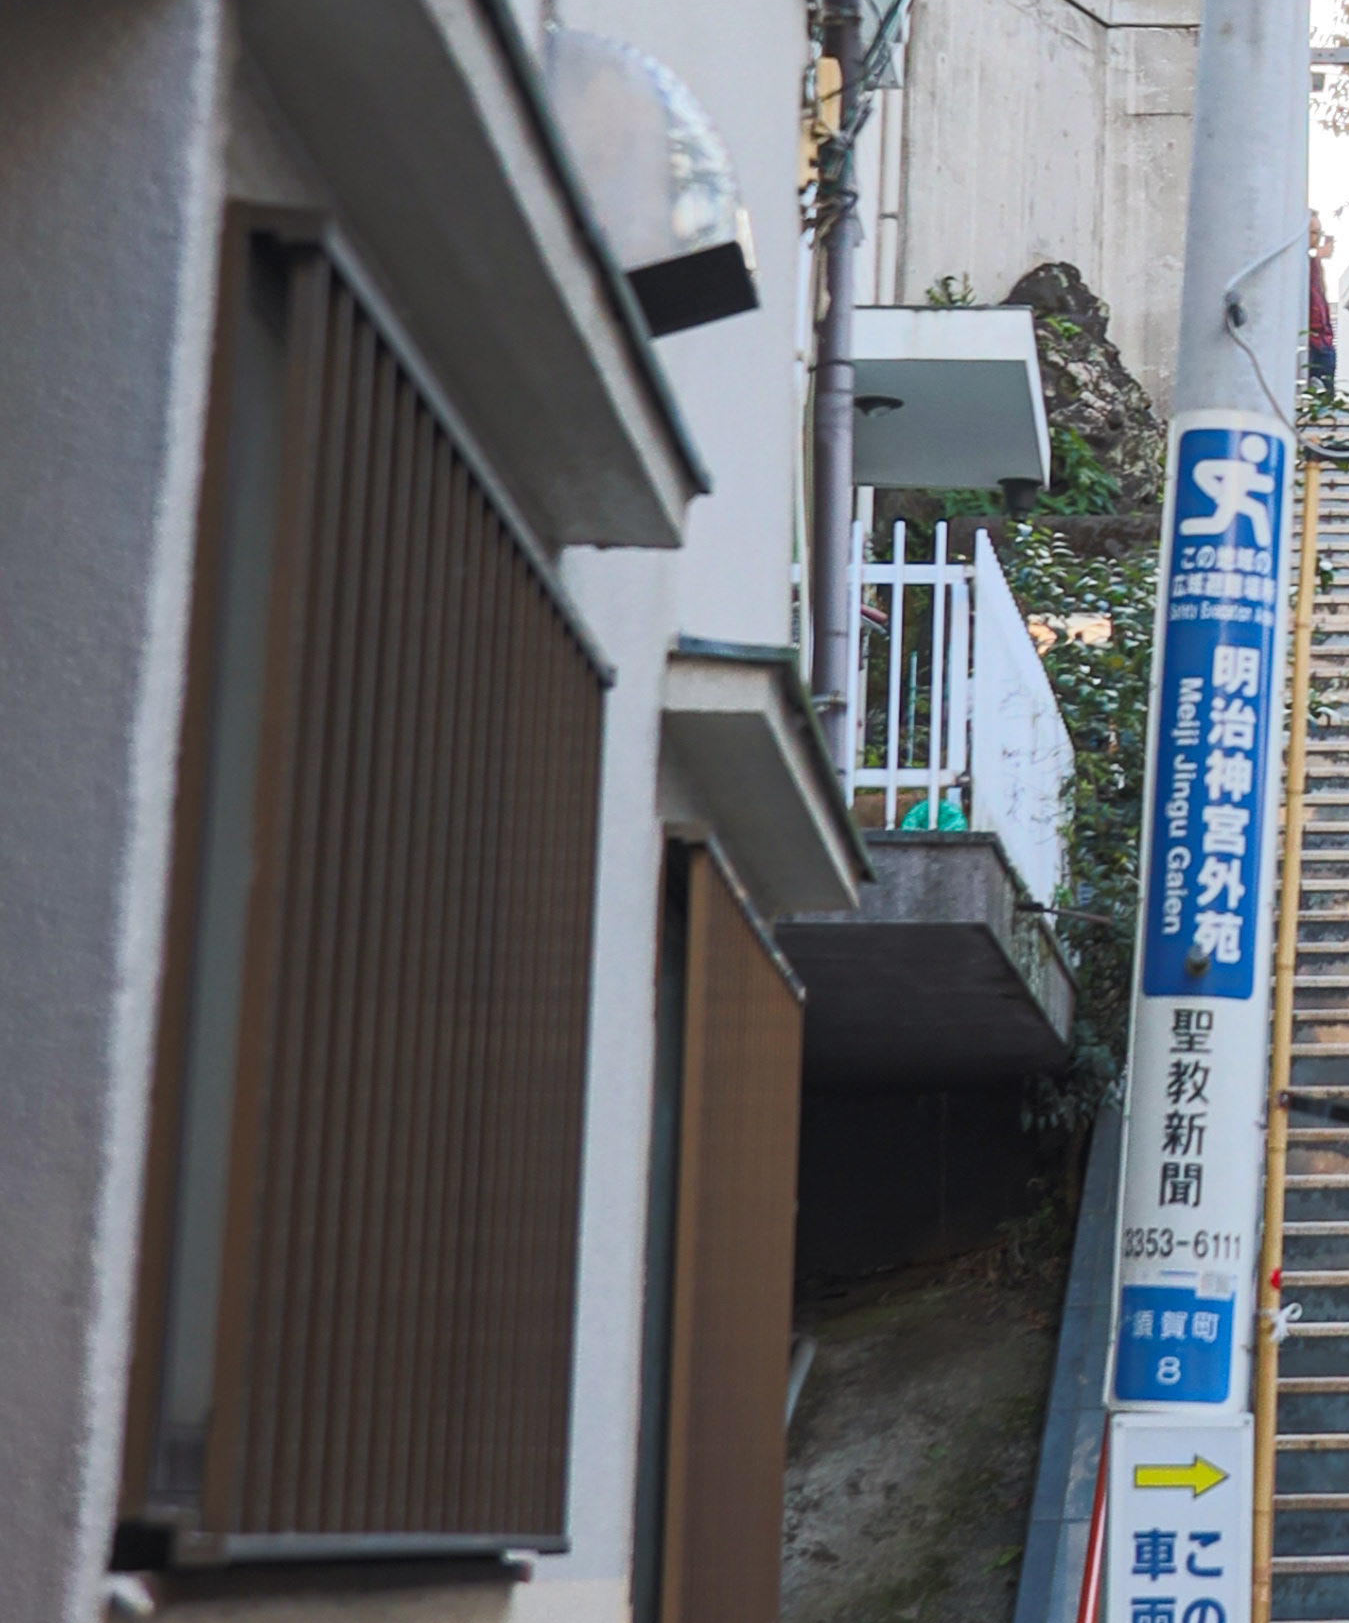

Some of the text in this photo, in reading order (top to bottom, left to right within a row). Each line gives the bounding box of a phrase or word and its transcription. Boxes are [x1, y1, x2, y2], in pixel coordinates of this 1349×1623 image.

[1161, 676, 1204, 936] Meiji Jingu Gaien
[1192, 644, 1261, 965] 明治神宮外苑
[1157, 1007, 1214, 1211] 聖教新聞
[1132, 1309, 1220, 1344] 須賀町
[1155, 1355, 1182, 1386] 8
